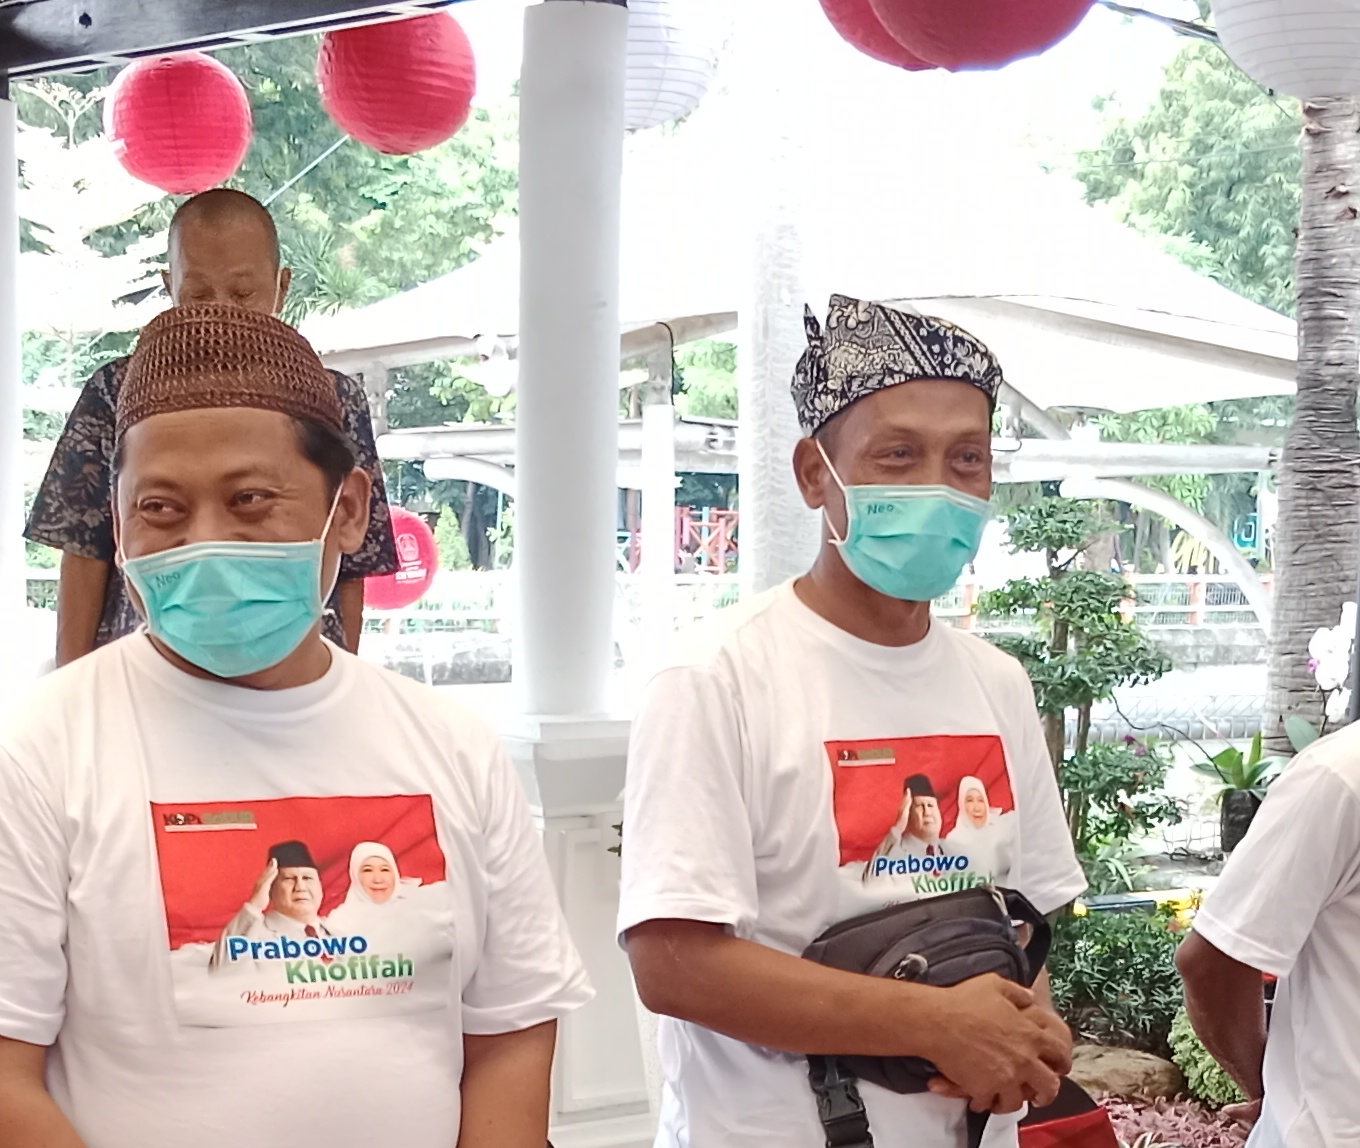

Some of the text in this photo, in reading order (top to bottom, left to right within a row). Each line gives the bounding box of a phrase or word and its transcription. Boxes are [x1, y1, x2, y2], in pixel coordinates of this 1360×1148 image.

[875, 854, 969, 876] Prabowo
[229, 936, 368, 961] Prabowo
[285, 953, 413, 984] Khofifah
[386, 981, 414, 995] 2024
